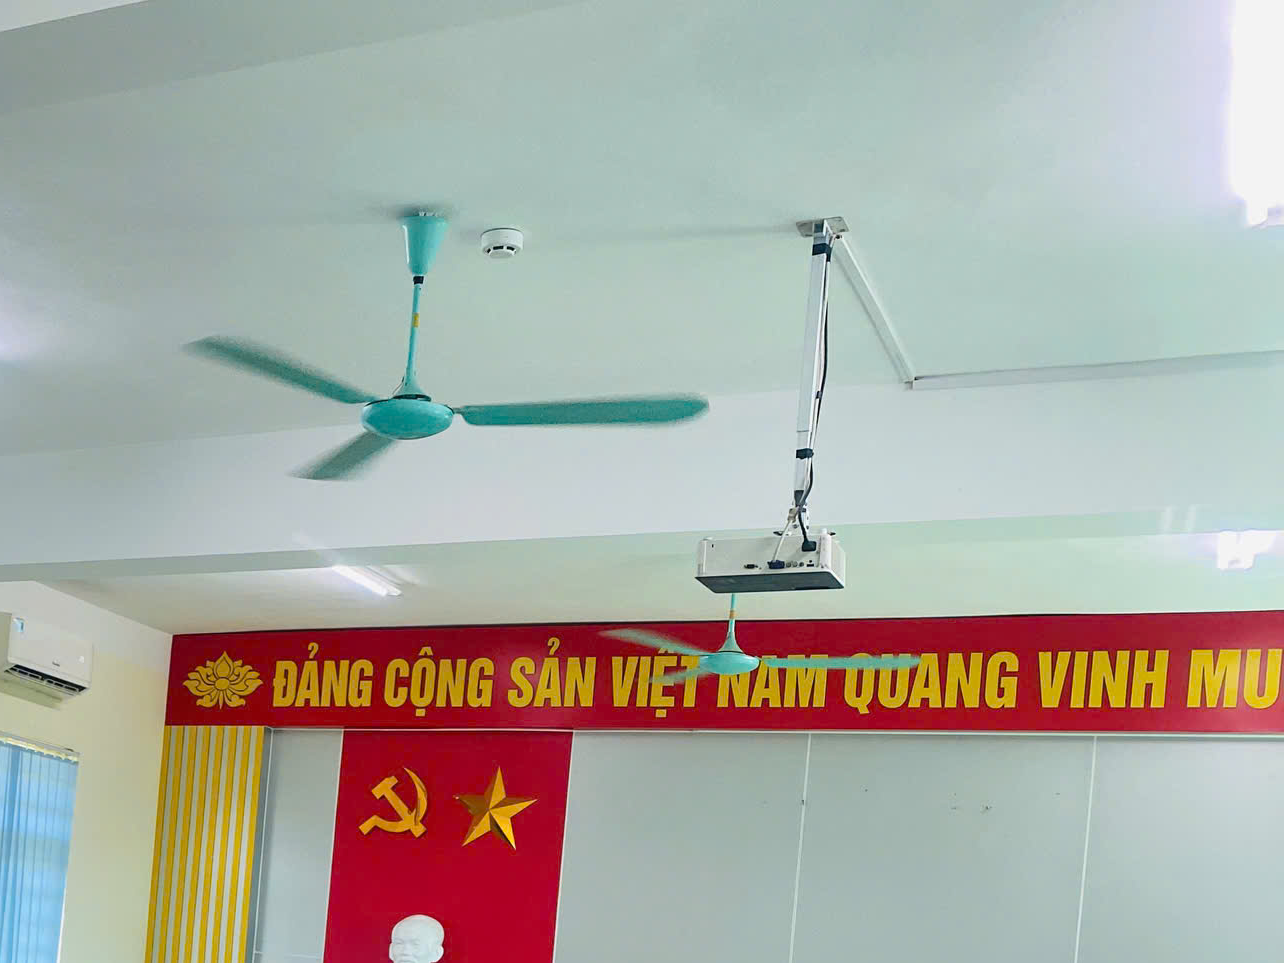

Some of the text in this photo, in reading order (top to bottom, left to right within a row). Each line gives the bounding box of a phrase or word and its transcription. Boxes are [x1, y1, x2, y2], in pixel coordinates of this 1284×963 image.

[273, 637, 1282, 718] ĐẢNG CỘNG SẢN VIỆT NAM QUANG VINH MU
